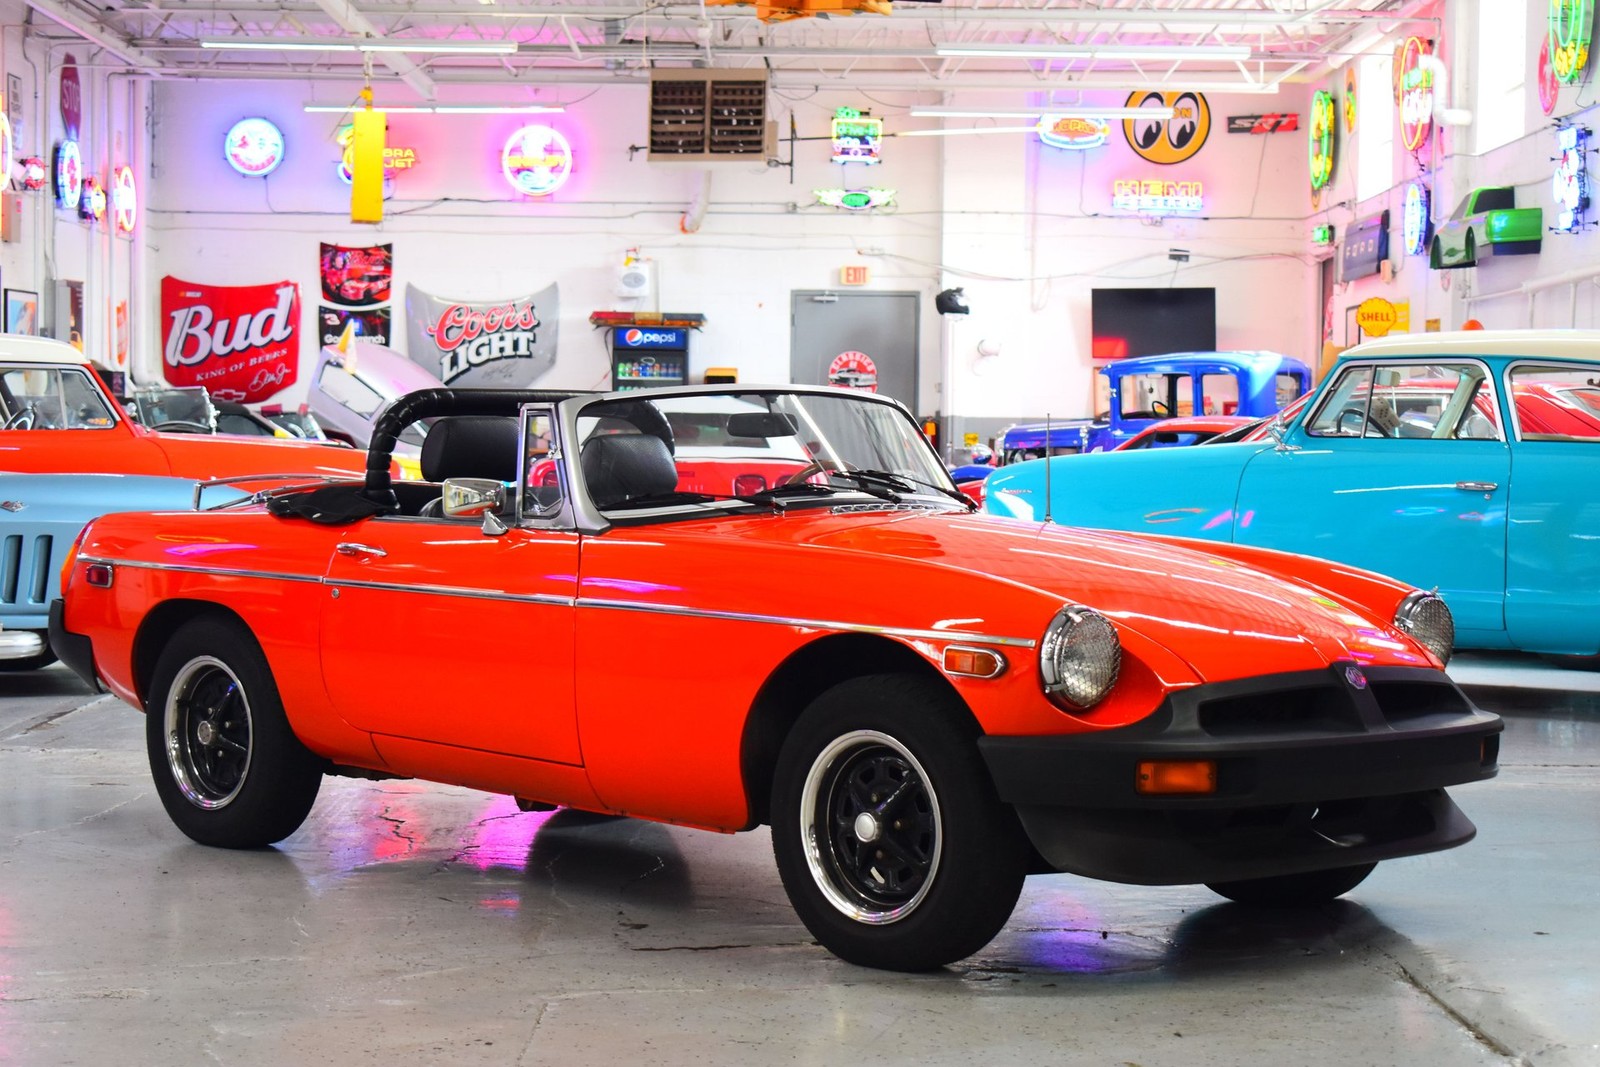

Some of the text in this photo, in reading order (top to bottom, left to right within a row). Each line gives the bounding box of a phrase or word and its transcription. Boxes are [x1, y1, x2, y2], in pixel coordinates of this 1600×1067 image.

[1229, 117, 1296, 132] SRT
[383, 148, 414, 158] BRA
[384, 158, 415, 168] JET
[1114, 181, 1203, 197] HEMI
[846, 266, 868, 283] EXIT
[1361, 312, 1391, 322] SHELL
[165, 286, 295, 368] Bud
[427, 301, 540, 352] Coors
[643, 332, 676, 344] pepsi
[195, 348, 288, 381] KING OF BEERS
[440, 331, 536, 385] LIGHT
